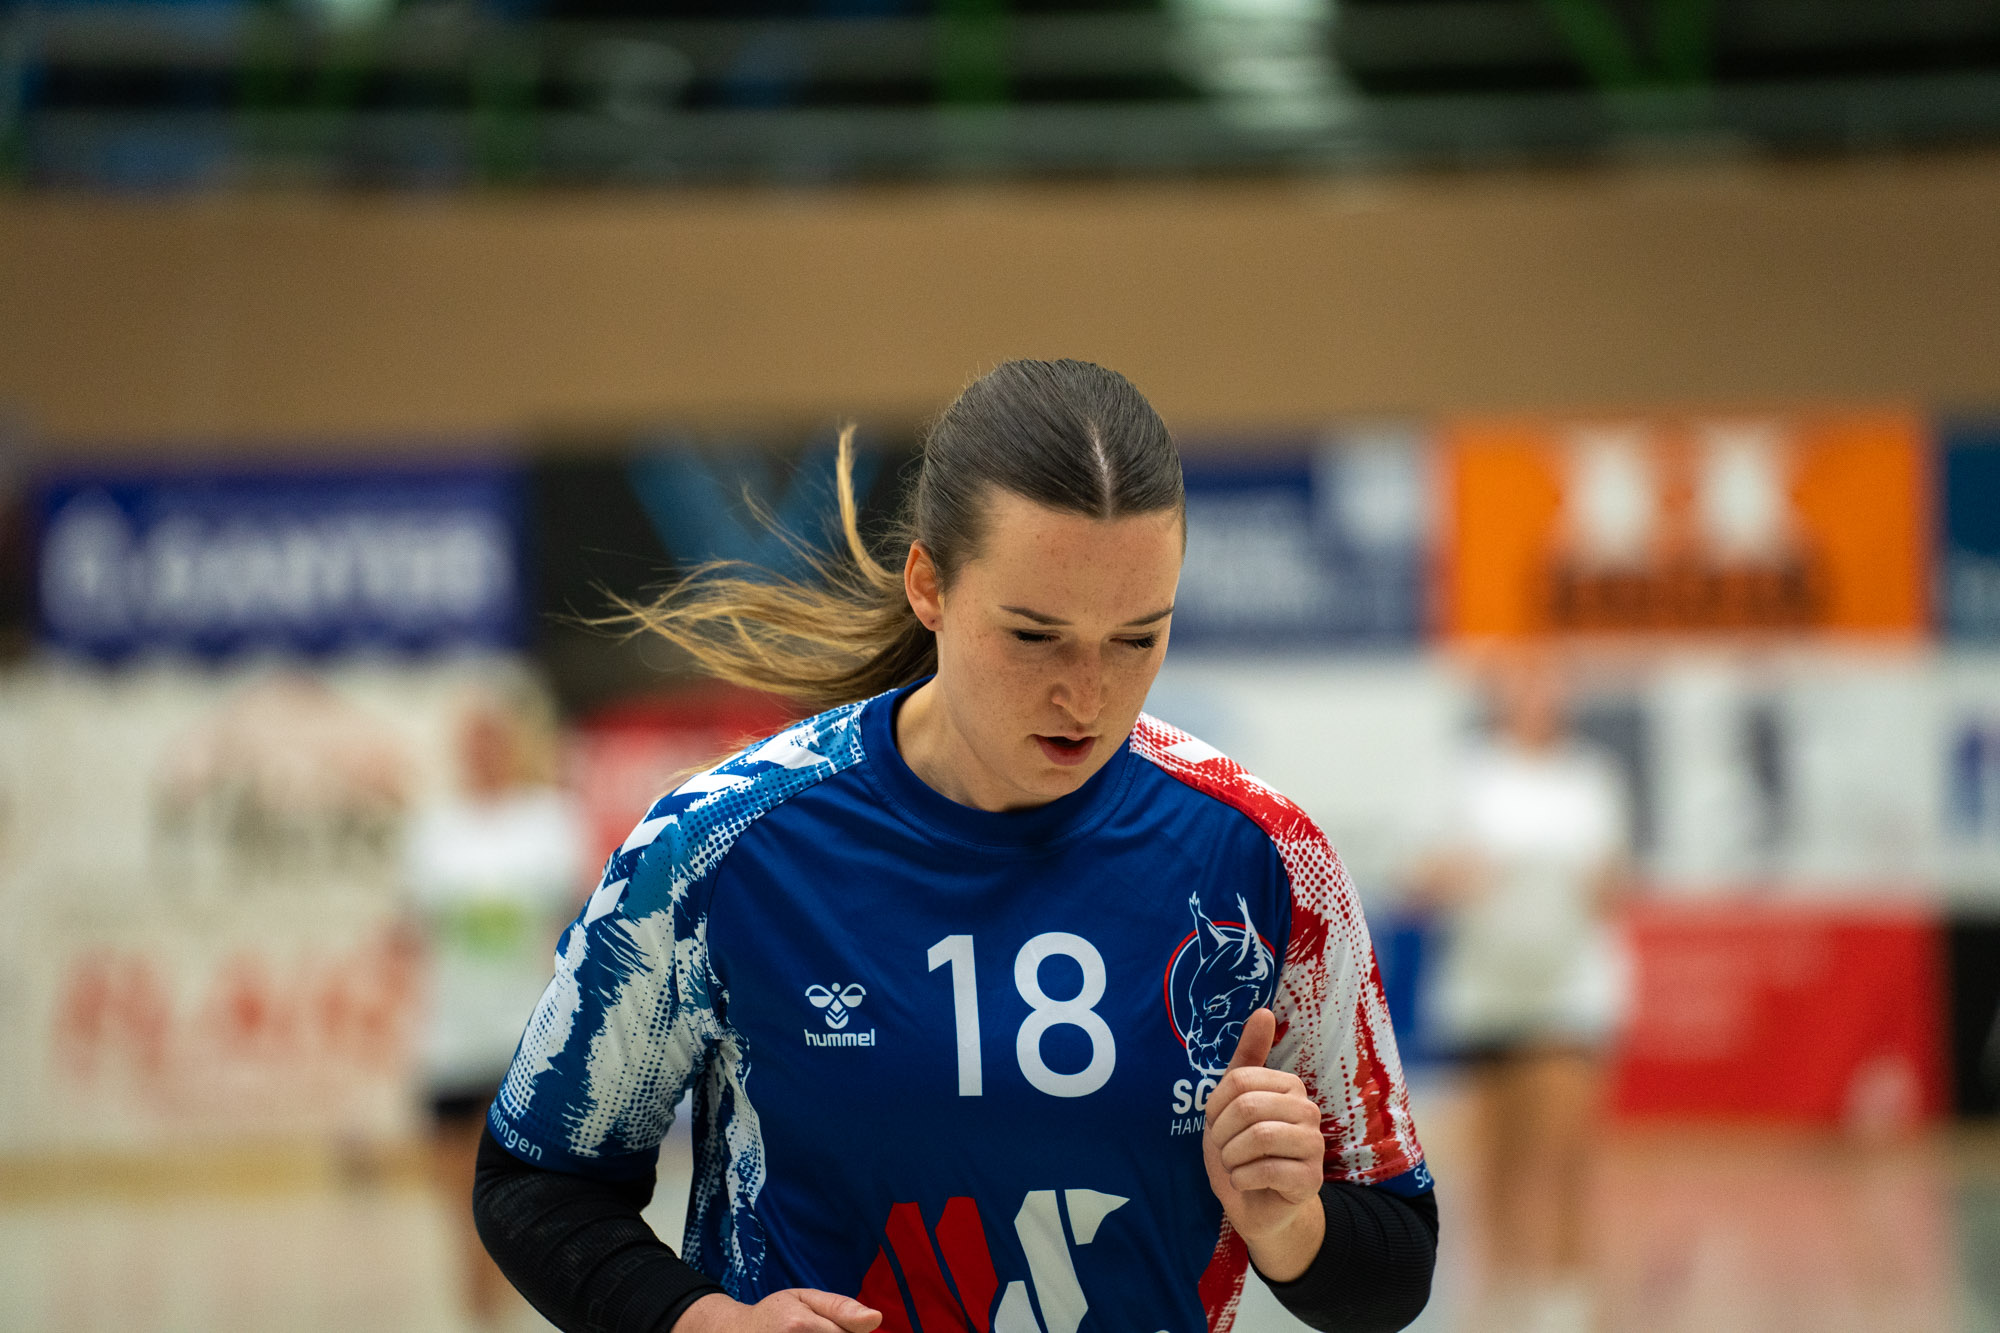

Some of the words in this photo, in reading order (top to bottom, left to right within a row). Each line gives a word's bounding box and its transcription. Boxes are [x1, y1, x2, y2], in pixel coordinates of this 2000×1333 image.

[927, 931, 1116, 1097] 18
[803, 1028, 876, 1047] hummel
[1170, 1115, 1206, 1136] HAN
